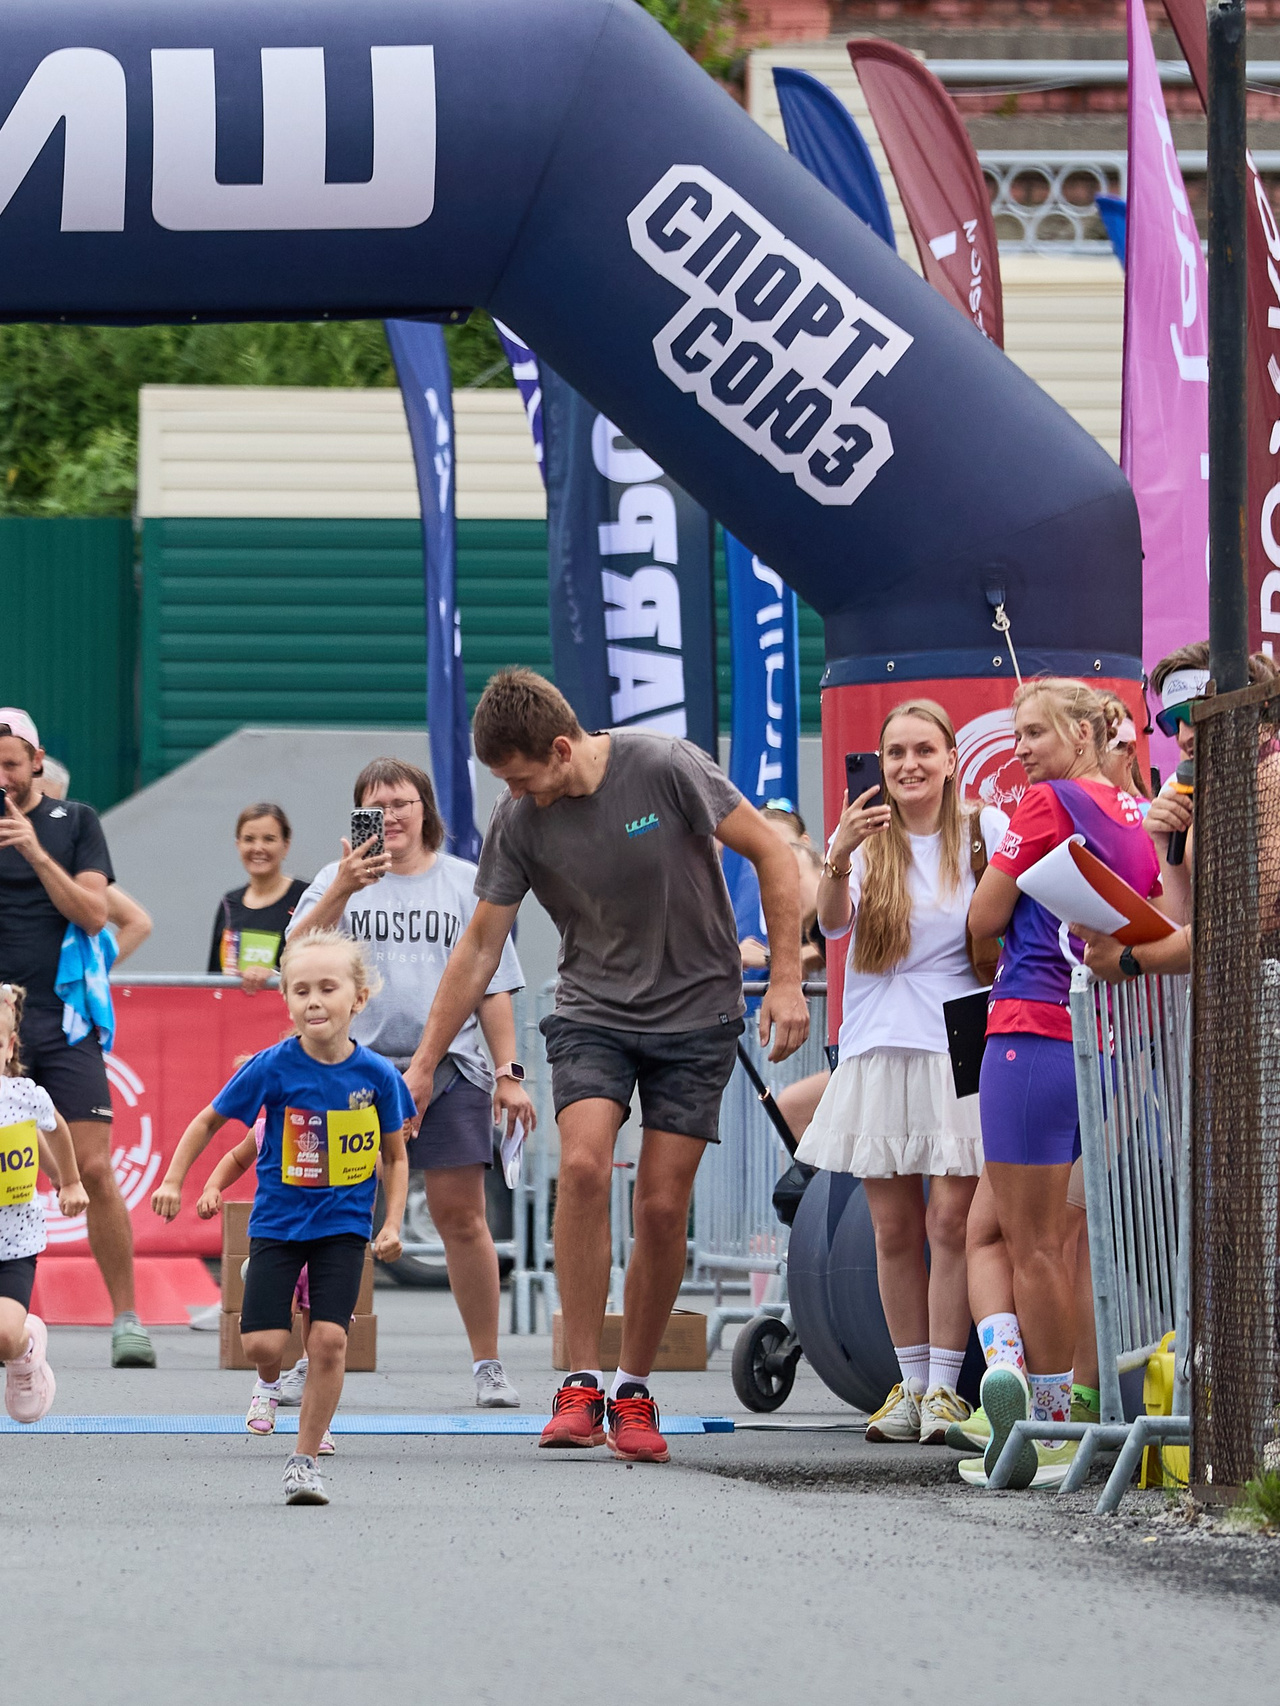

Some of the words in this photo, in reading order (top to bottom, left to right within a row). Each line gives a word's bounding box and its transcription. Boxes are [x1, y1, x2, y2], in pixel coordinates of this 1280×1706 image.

[645, 181, 890, 389] СПОРТ
[670, 307, 874, 488] СОЮЗ
[376, 951, 437, 963] RUSSIA
[339, 1131, 375, 1154] 103
